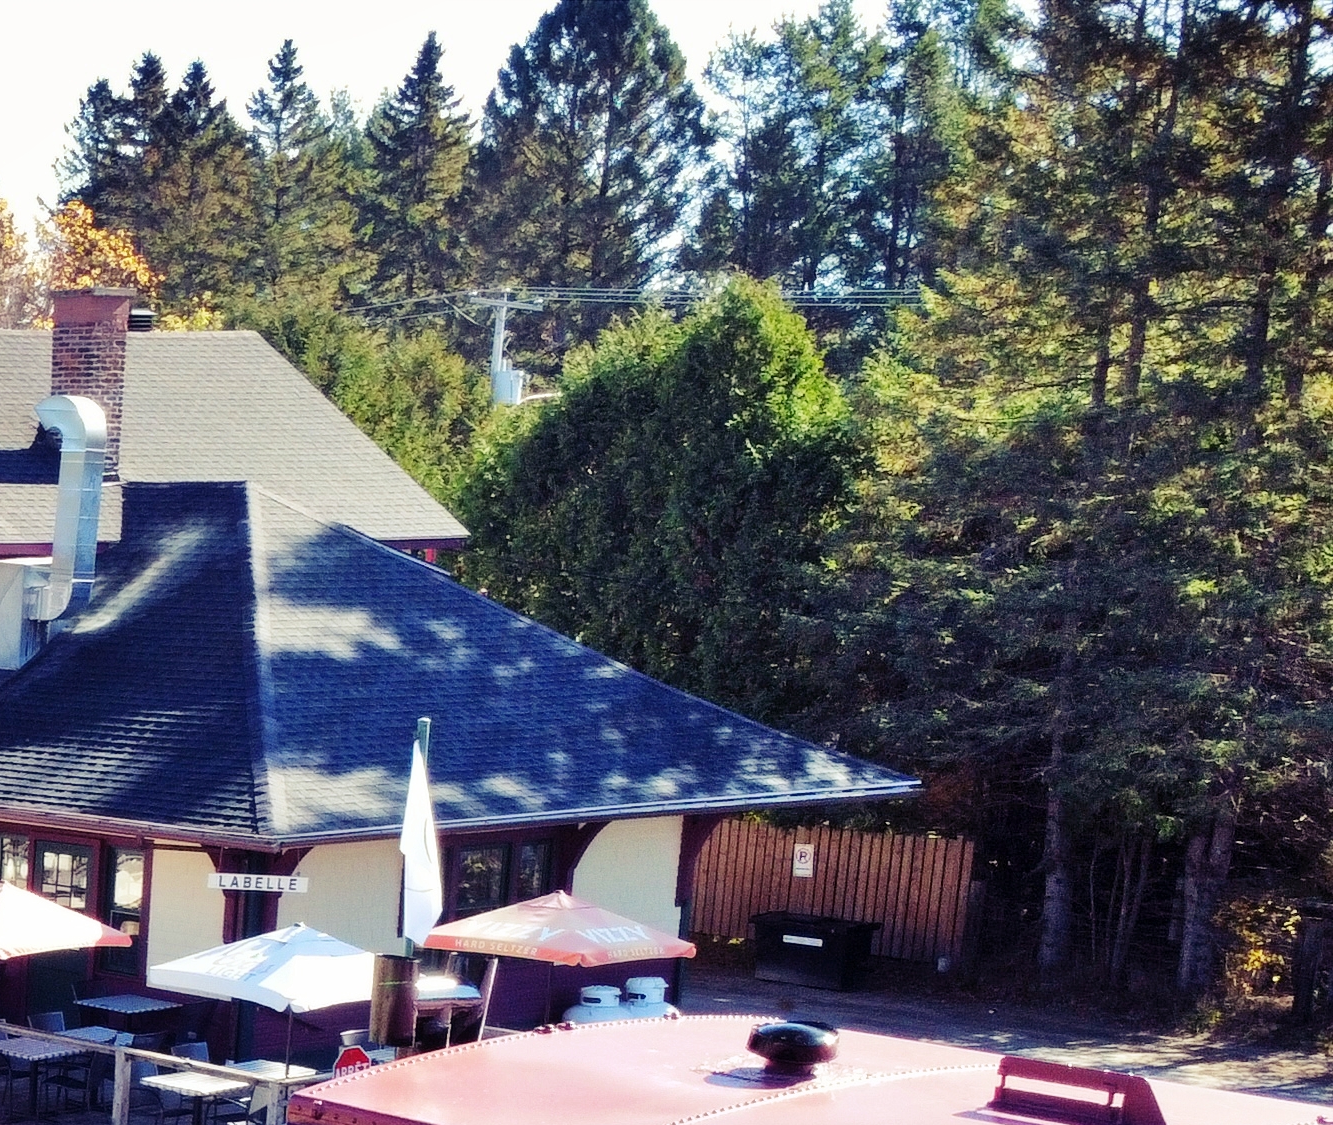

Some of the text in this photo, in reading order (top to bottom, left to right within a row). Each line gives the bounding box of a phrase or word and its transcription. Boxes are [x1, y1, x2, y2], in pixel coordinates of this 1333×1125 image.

[218, 875, 298, 891] LABELLE
[470, 920, 565, 942] VIZZY
[574, 925, 652, 943] VIZZY
[454, 938, 538, 956] HARD SELTZER
